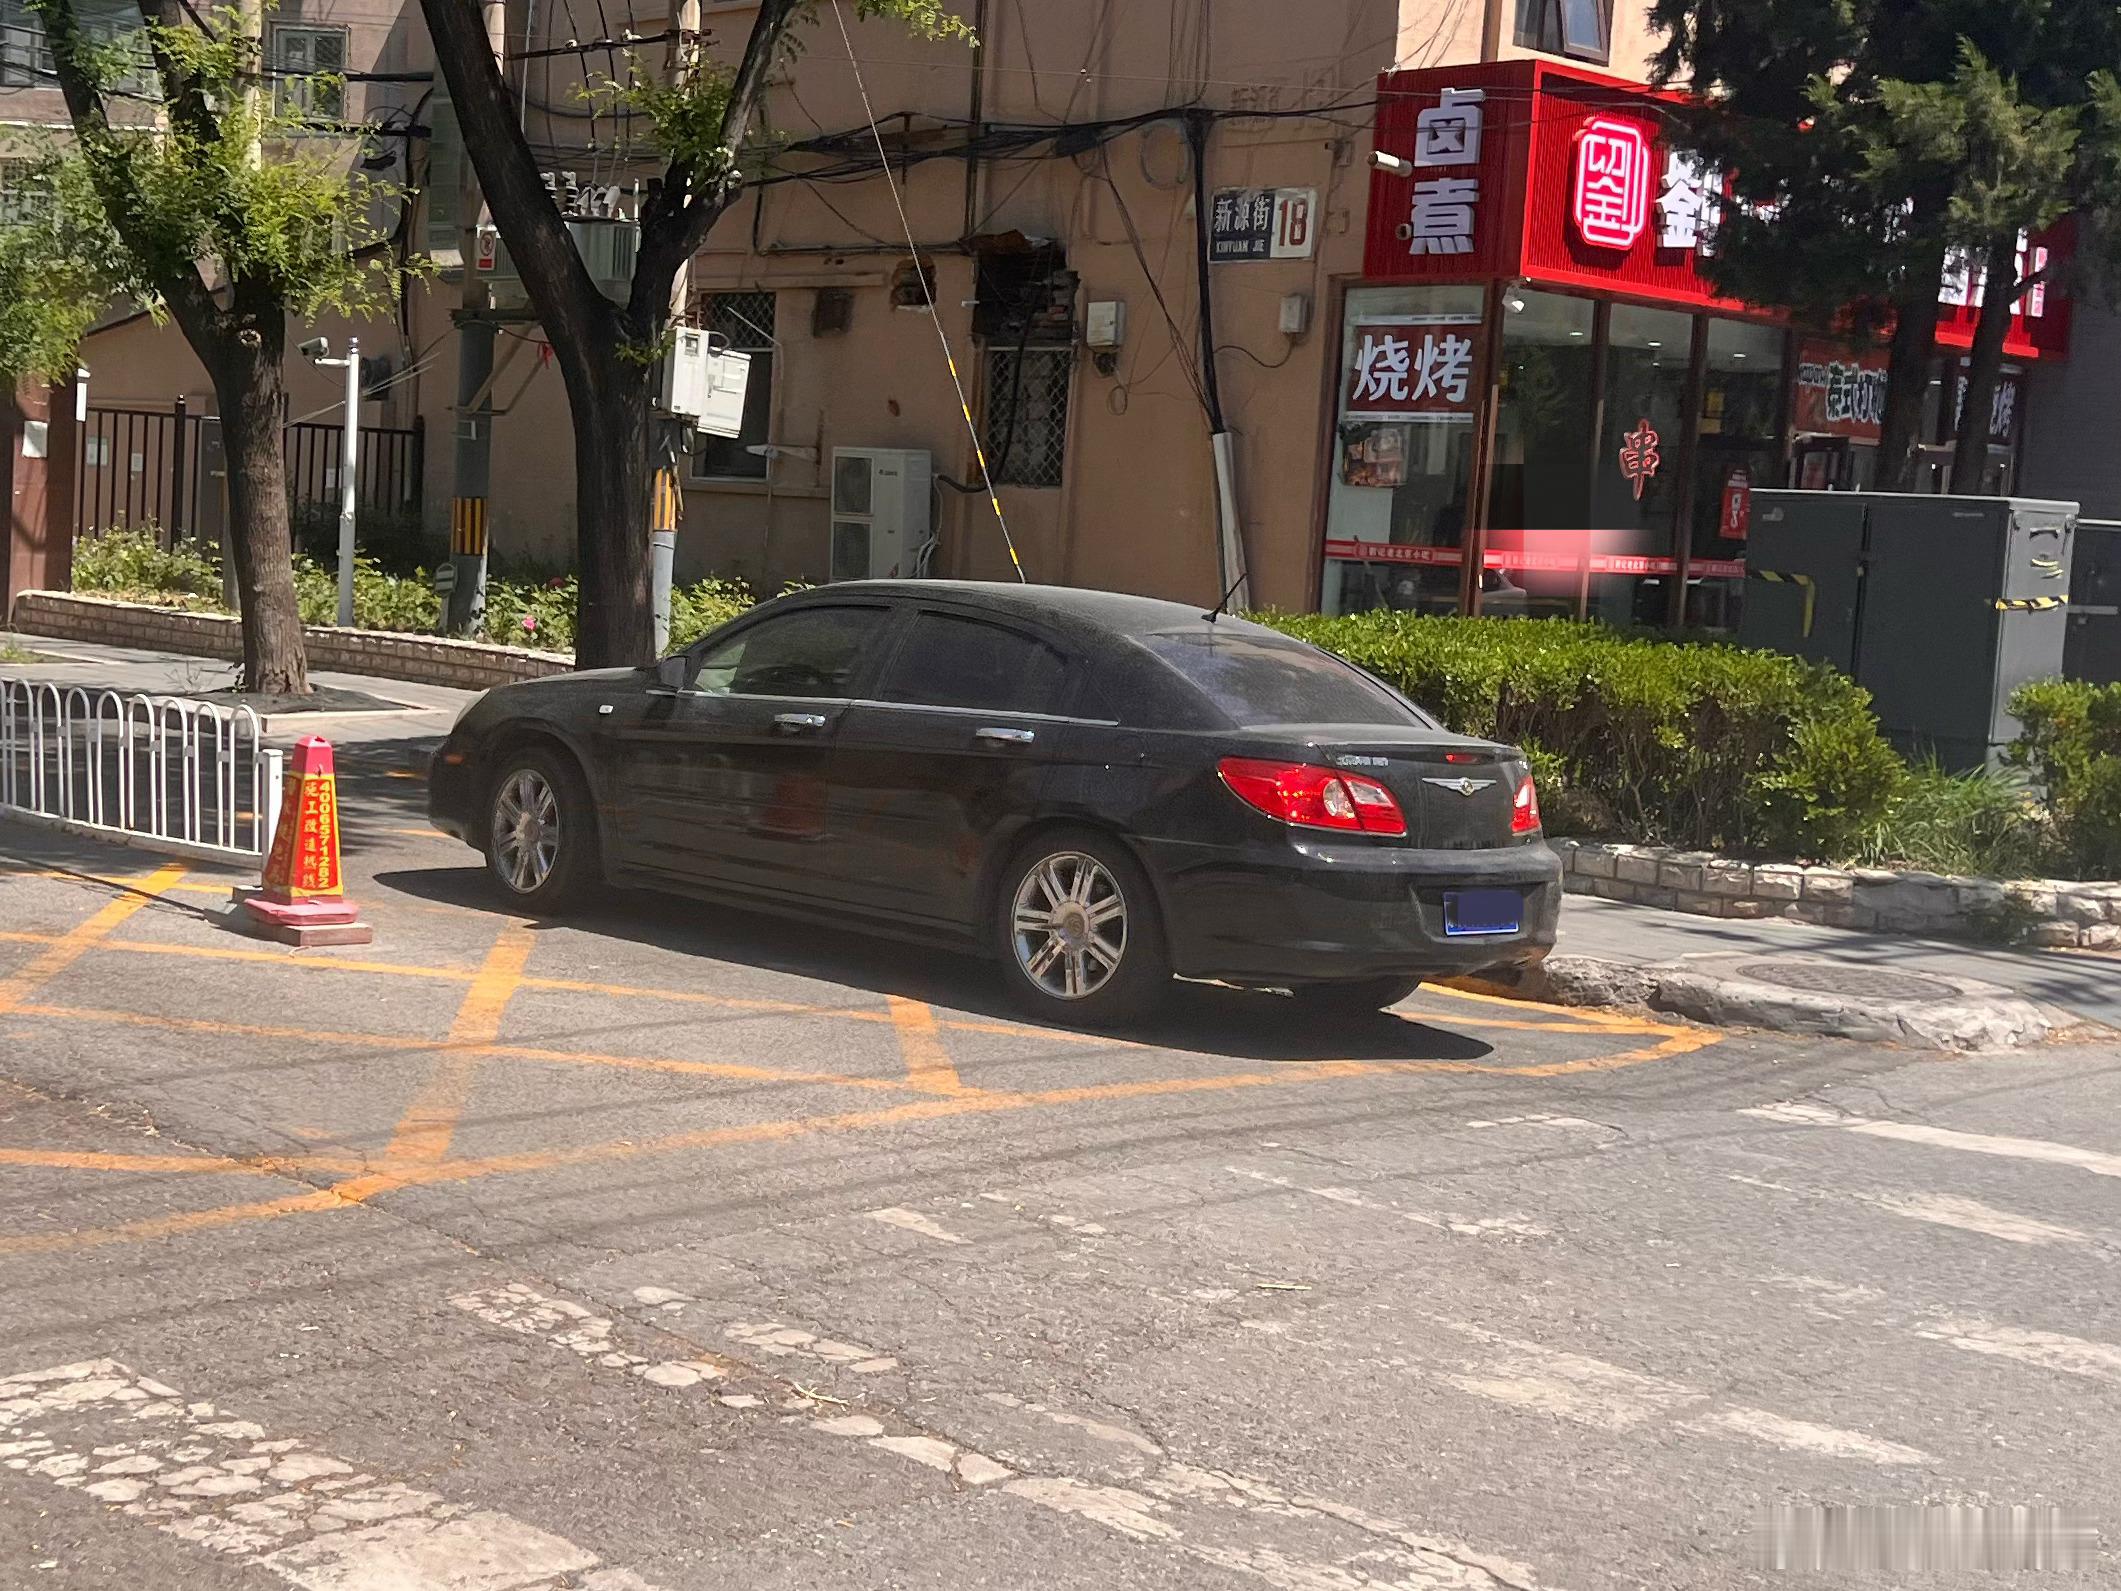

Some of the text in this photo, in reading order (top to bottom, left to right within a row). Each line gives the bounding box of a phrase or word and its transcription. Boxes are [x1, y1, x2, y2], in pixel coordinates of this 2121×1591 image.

[1409, 87, 1486, 255] 卤煮
[1279, 198, 1308, 246] 18
[1352, 333, 1472, 402] 烧烤
[318, 780, 332, 889] 4006571282
